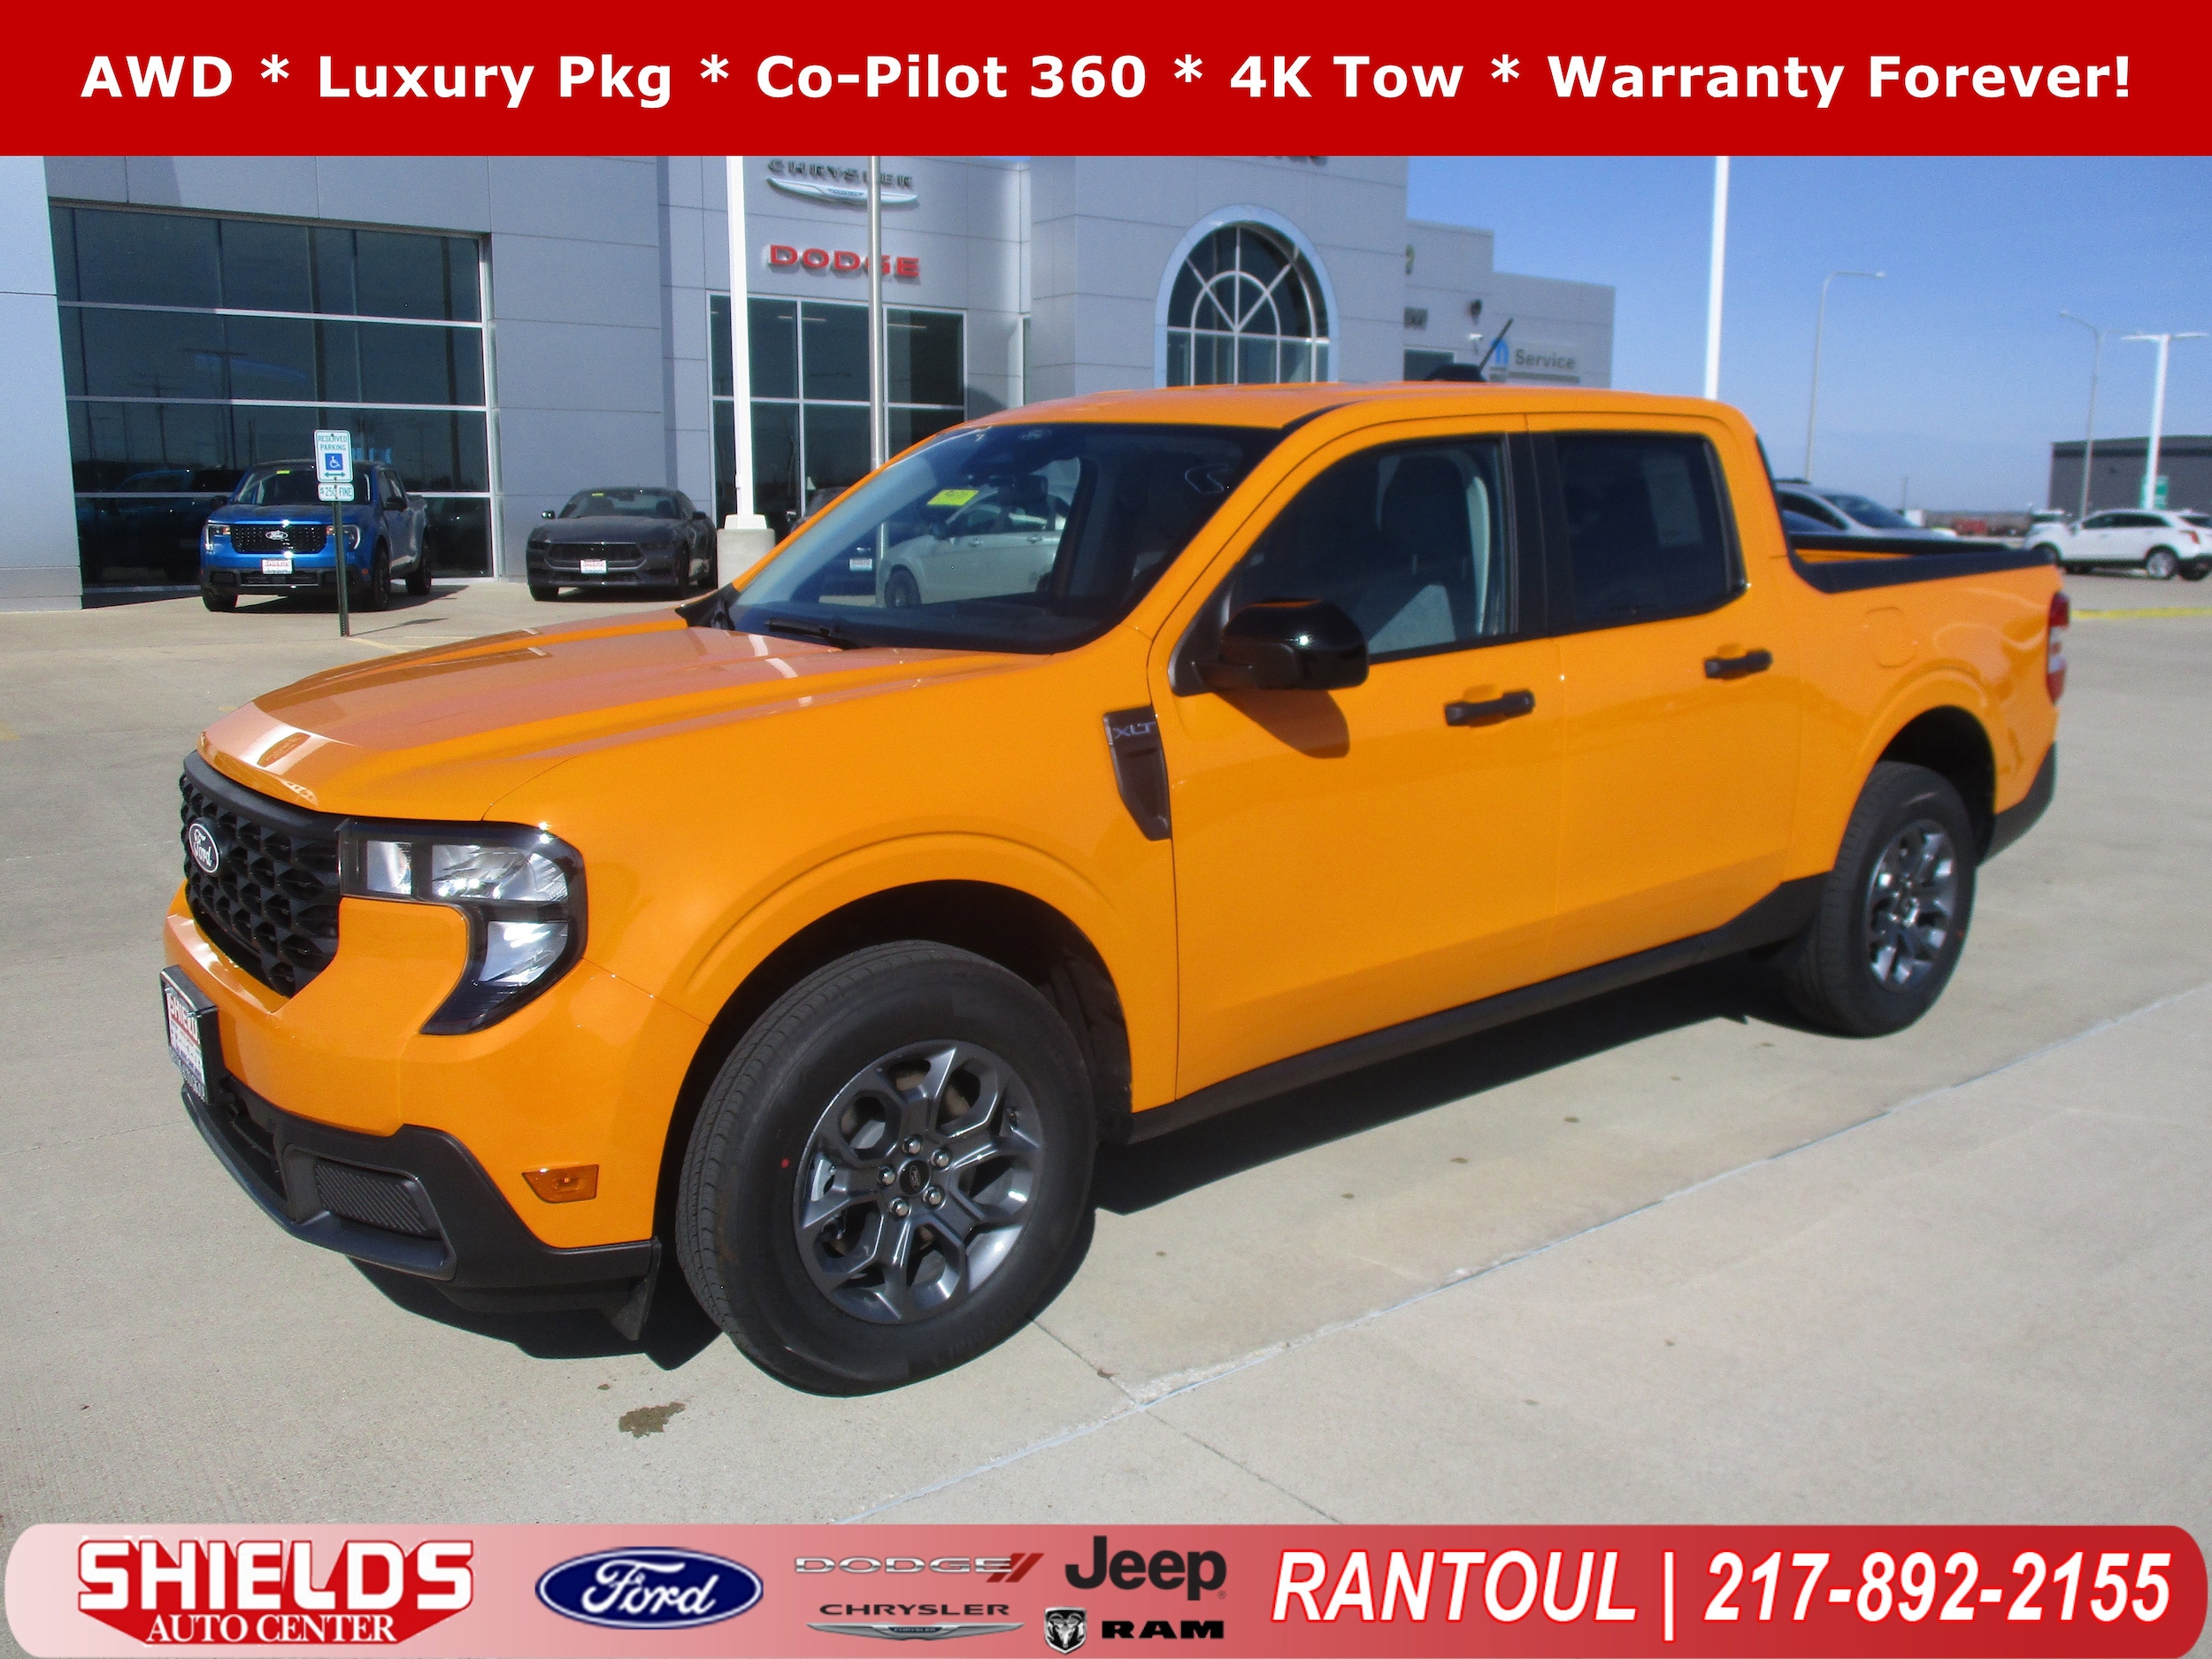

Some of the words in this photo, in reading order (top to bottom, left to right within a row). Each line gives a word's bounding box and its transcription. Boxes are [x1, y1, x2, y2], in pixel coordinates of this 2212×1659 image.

[1515, 349, 1576, 370] Service
[339, 488, 352, 496] FINE
[1113, 721, 1156, 740] XLT
[194, 828, 213, 867] Ford
[168, 993, 201, 1046] SHIELD
